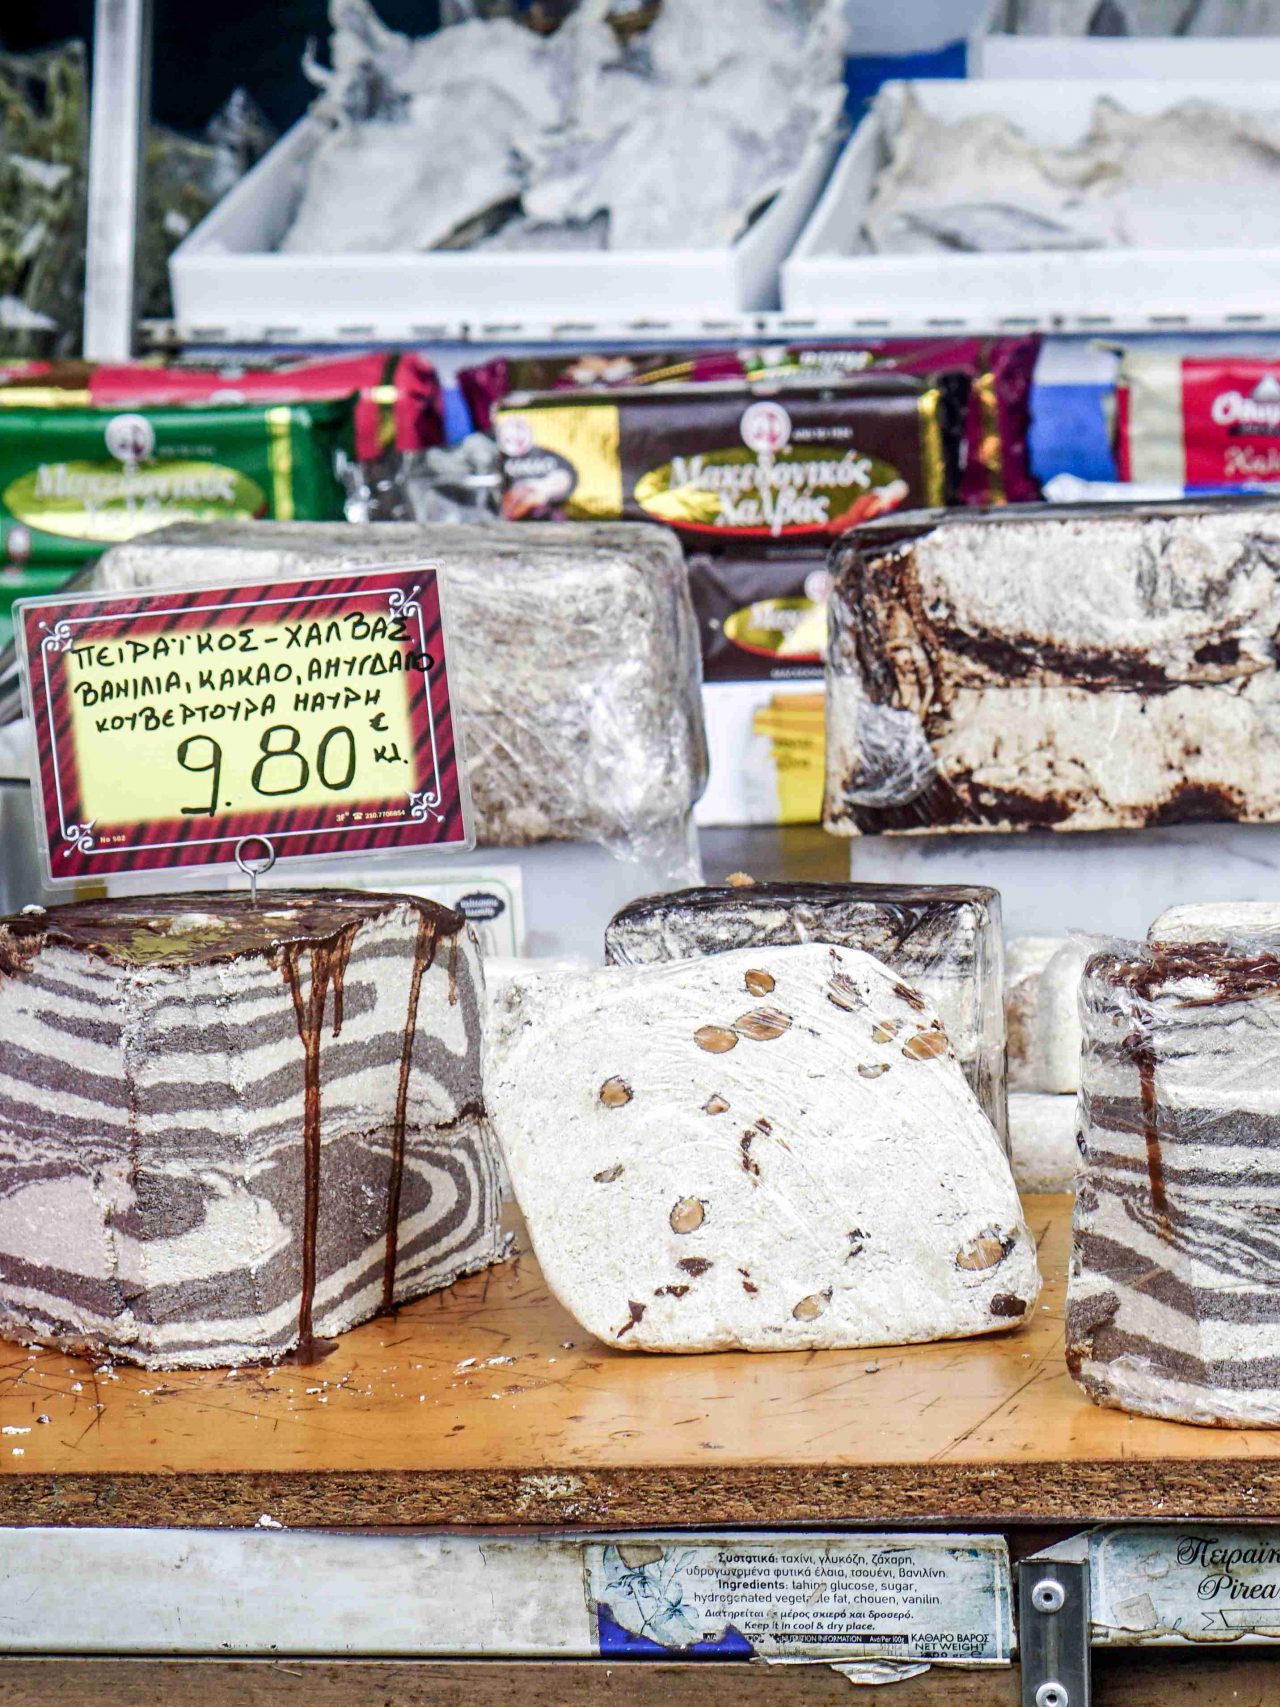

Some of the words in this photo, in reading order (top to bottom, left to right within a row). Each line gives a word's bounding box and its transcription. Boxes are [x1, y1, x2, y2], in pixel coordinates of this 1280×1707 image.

[96, 694, 275, 733] ΚΟΥΒΕΡΤΟΥΡΑ
[177, 725, 356, 817] 9.80
[718, 1553, 778, 1563] Συστατικά:
[781, 1553, 815, 1565] ταχίνι,
[819, 1553, 868, 1566] γλυκόζη,
[871, 1553, 915, 1566] ζάχαρη,
[773, 1567, 811, 1579] φυτικά
[814, 1567, 847, 1579] έλαια,
[851, 1567, 895, 1579] τσουένι,
[899, 1568, 949, 1578] βανιλίνη.
[718, 1579, 788, 1591] Ingredients:
[830, 1580, 877, 1592] glucose,
[881, 1582, 917, 1593] sugar,
[694, 1592, 772, 1605] hydrogenated
[833, 1594, 851, 1605] fat,
[853, 1594, 899, 1605] chouen,
[902, 1594, 942, 1604] vanilin.
[705, 1608, 764, 1619] Διατηρείται
[780, 1609, 809, 1620] μέρος
[813, 1609, 846, 1620] σκιερό
[868, 1610, 914, 1620] δροσερό.
[744, 1621, 769, 1632] Keep
[793, 1621, 814, 1630] cool
[816, 1622, 824, 1630] &
[827, 1622, 843, 1632] dry
[846, 1622, 875, 1632] place.
[818, 1635, 862, 1643] INFORMATION
[911, 1633, 954, 1642] ΚΑΘΑΡΟ
[957, 1633, 989, 1643] ΒΑΡΟΣ
[915, 1643, 937, 1651] NET
[940, 1642, 986, 1651] WEIGHT
